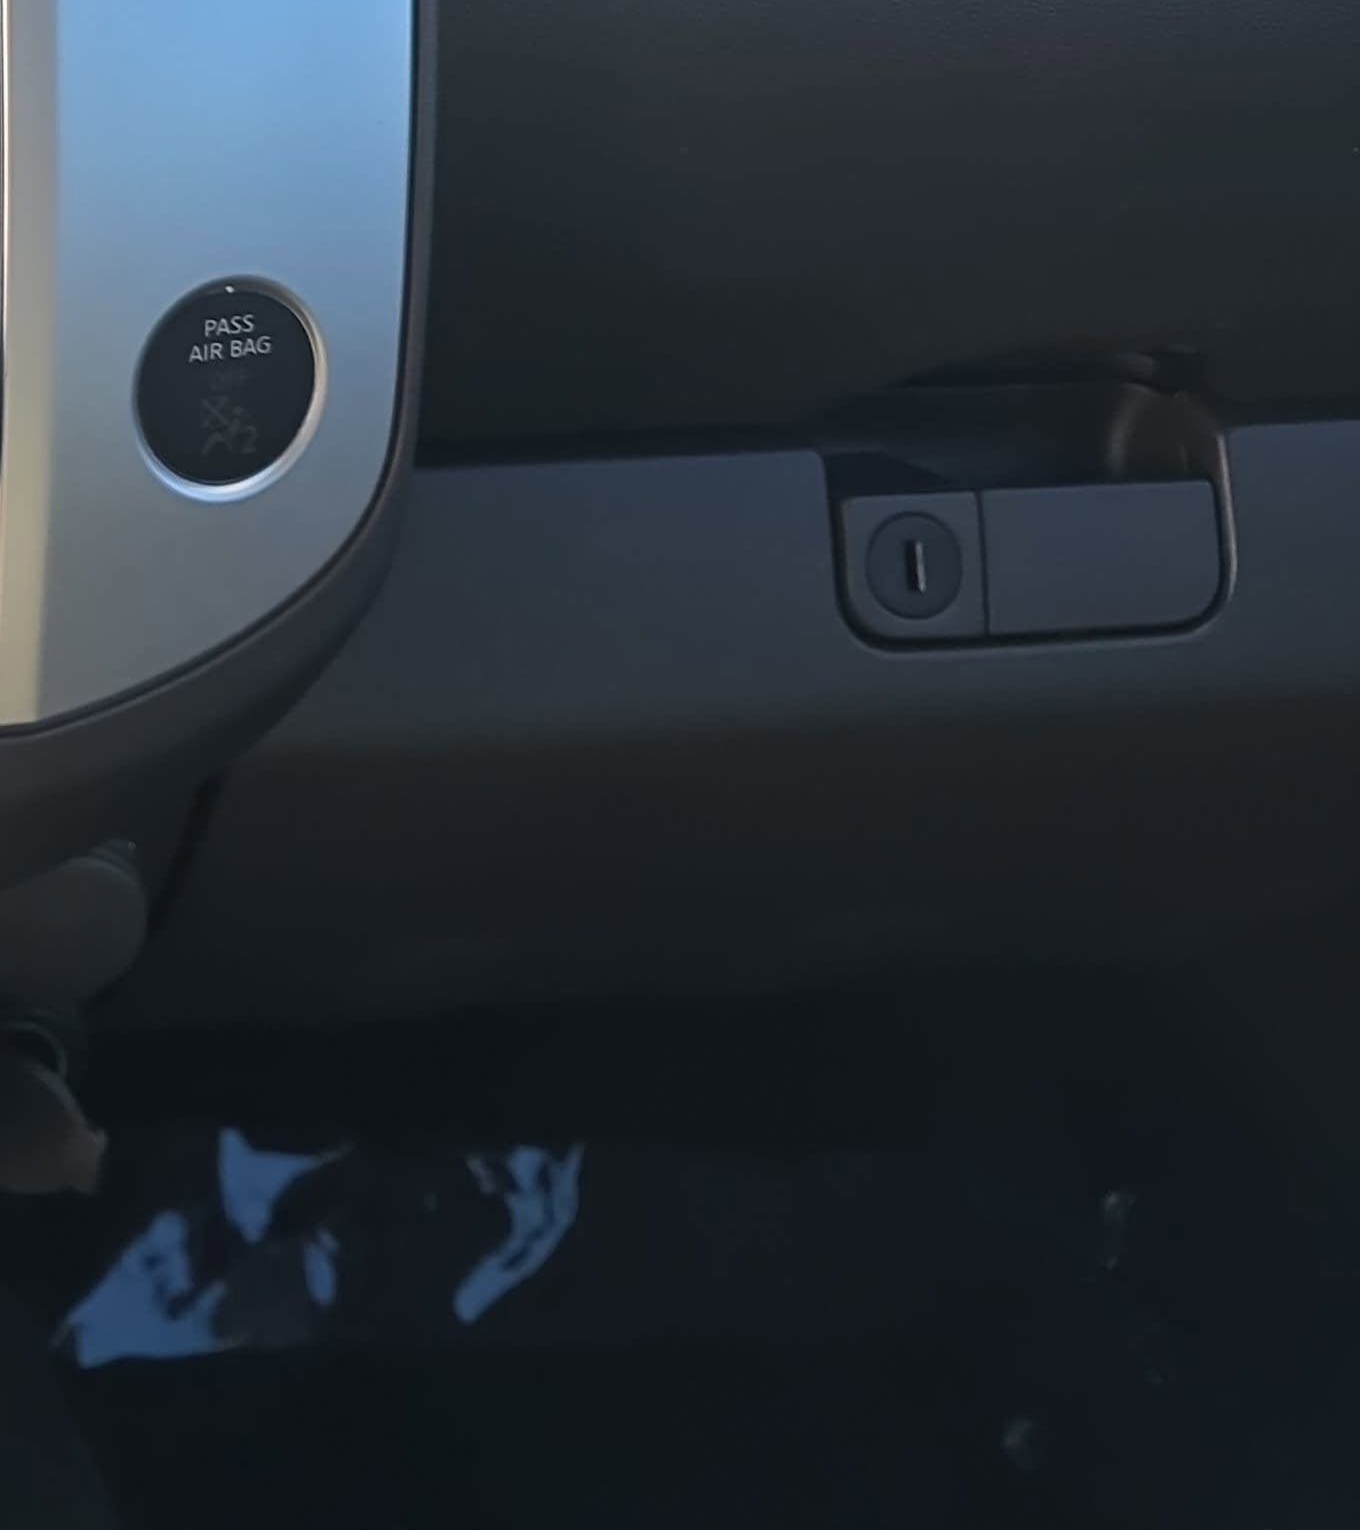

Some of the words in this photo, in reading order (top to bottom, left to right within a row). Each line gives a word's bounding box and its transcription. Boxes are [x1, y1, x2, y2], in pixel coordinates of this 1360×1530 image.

[204, 315, 254, 337] PASS
[190, 343, 222, 361] AIR
[231, 335, 272, 358] BAG
